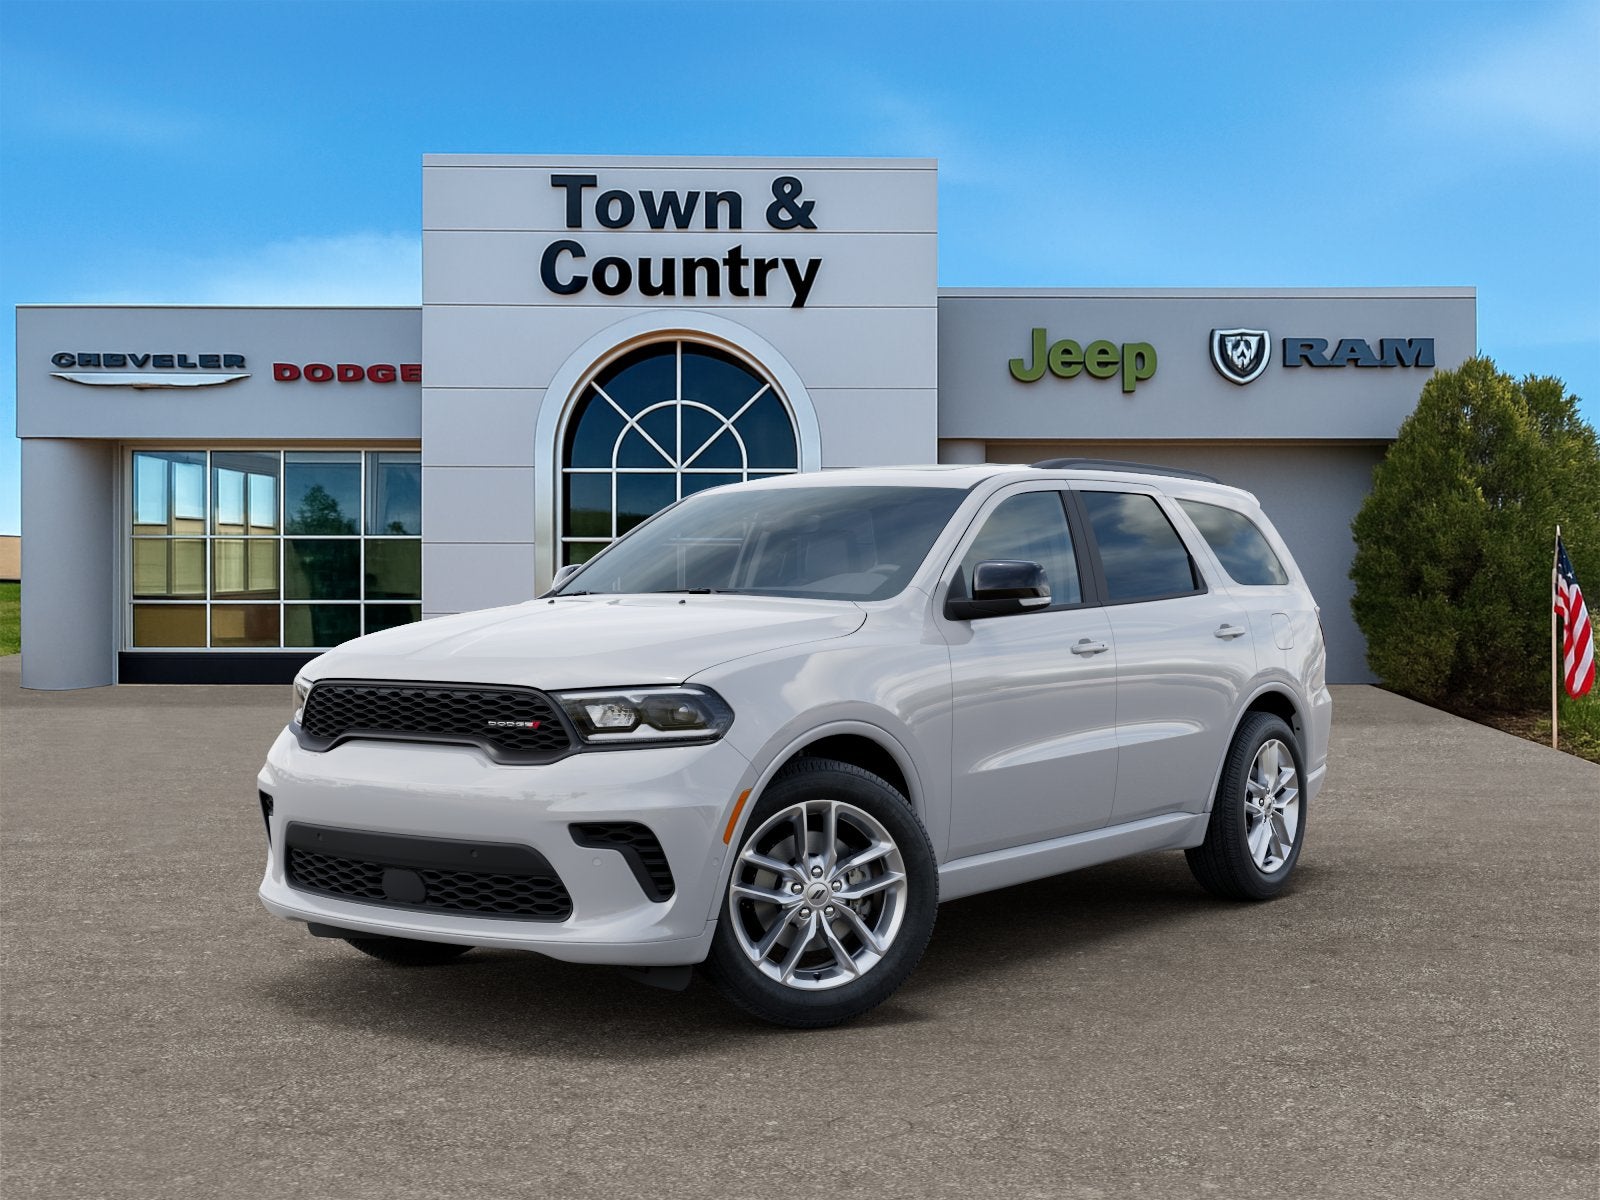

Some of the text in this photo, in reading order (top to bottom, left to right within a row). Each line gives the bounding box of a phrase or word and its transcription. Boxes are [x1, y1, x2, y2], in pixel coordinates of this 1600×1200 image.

[550, 174, 818, 230] Town &
[540, 239, 823, 308] Country
[273, 362, 422, 383] DODGE
[1009, 328, 1157, 393] Jeep
[1283, 337, 1436, 367] RAM
